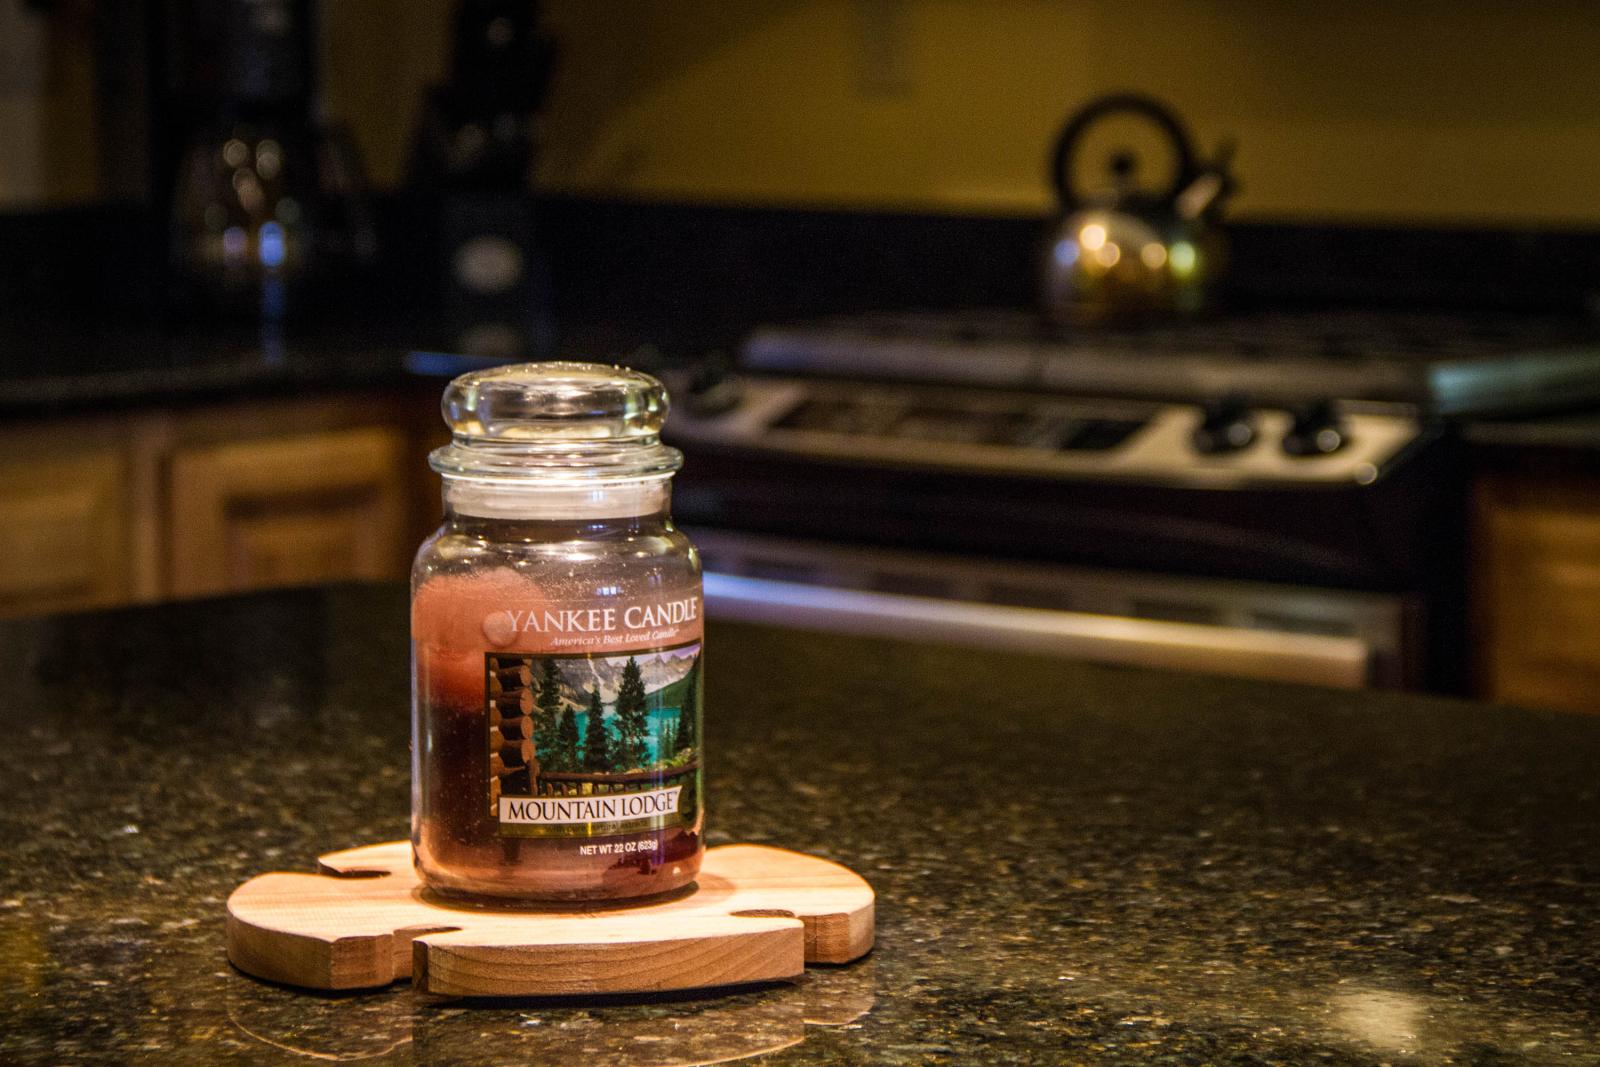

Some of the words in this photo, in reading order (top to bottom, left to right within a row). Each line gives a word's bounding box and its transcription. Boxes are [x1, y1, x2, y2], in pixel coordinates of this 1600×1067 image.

[506, 608, 616, 632] YANKEE
[624, 597, 698, 629] CANDLE
[550, 636, 600, 646] America's
[603, 635, 624, 645] Best
[625, 632, 651, 643] Loved
[508, 799, 616, 820] MOUNTAIN
[622, 792, 673, 817] LODGE
[579, 844, 597, 855] NET
[598, 843, 613, 854] WT
[614, 843, 624, 853] 22
[625, 841, 637, 852] OZ
[637, 839, 658, 852] (623g)
